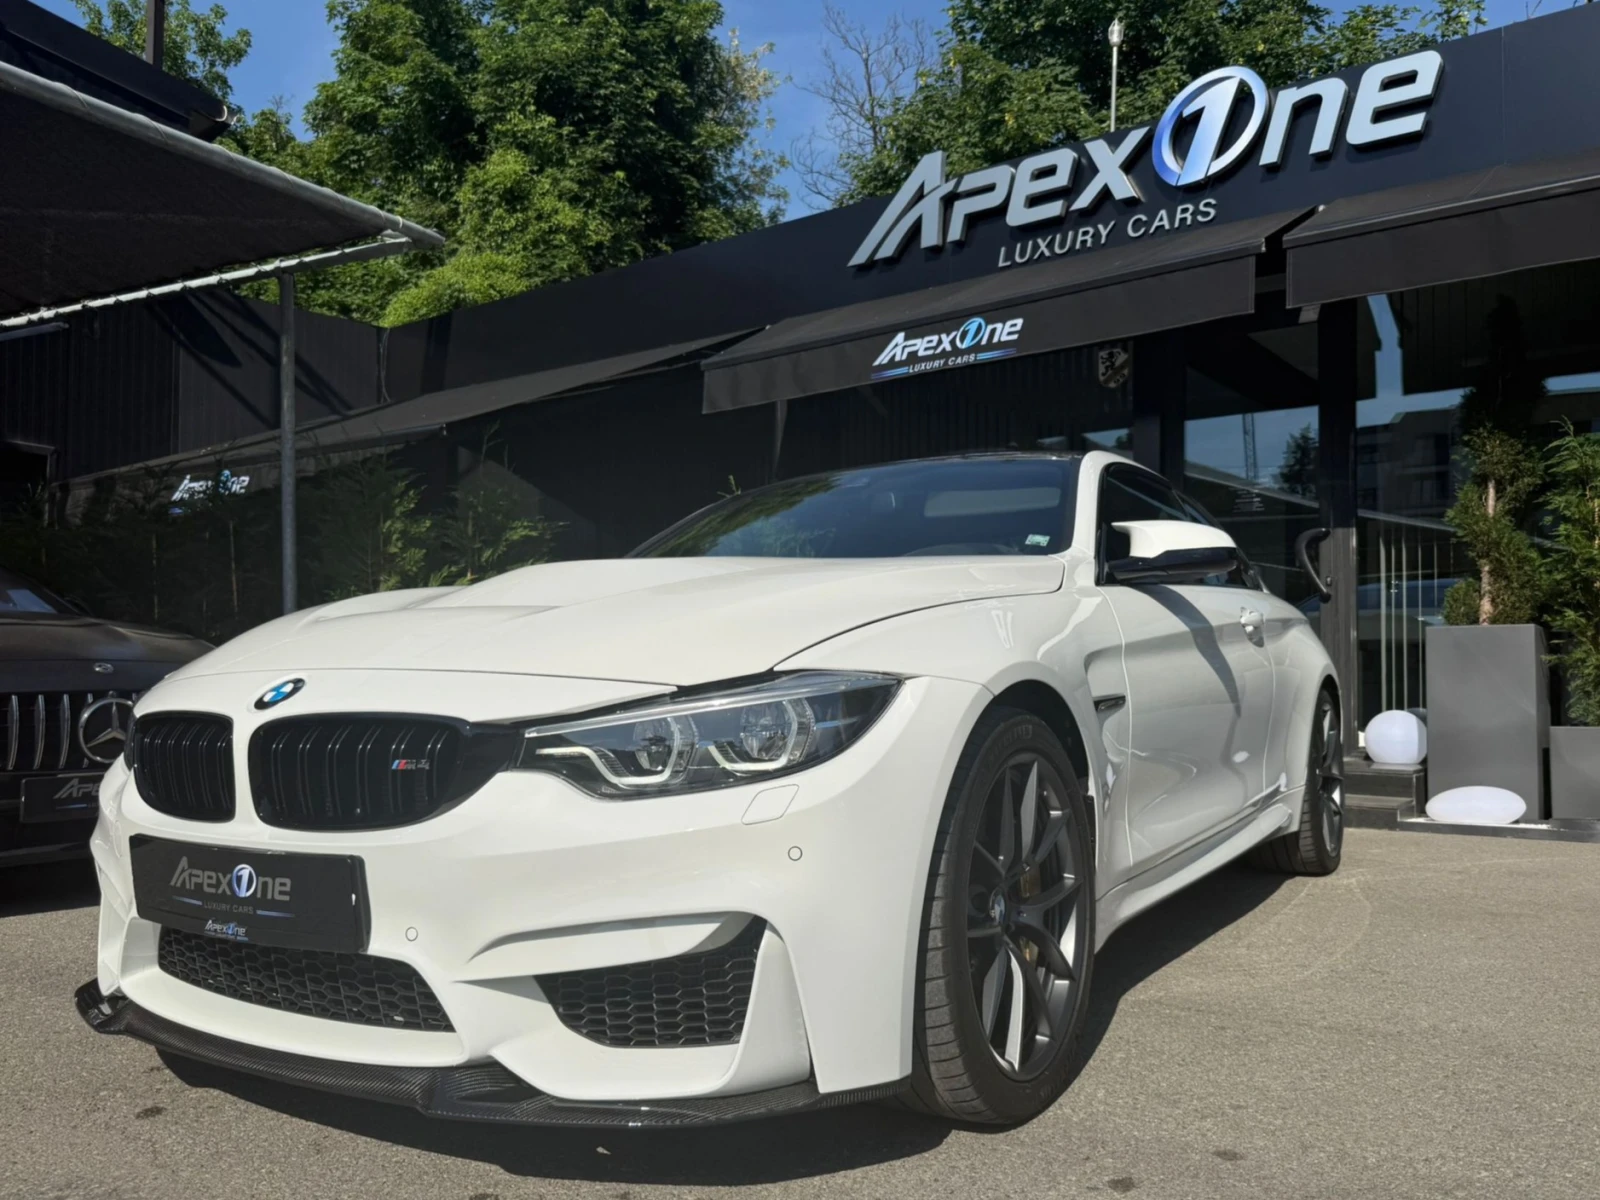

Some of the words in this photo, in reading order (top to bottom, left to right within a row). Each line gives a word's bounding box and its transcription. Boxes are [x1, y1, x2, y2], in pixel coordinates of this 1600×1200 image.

[997, 221, 1115, 269] LUXURY
[1126, 198, 1219, 239] CARS
[908, 358, 946, 373] LUXURY
[948, 353, 976, 366] CARS
[203, 900, 231, 913] LUXURY
[232, 904, 254, 915] CARS
